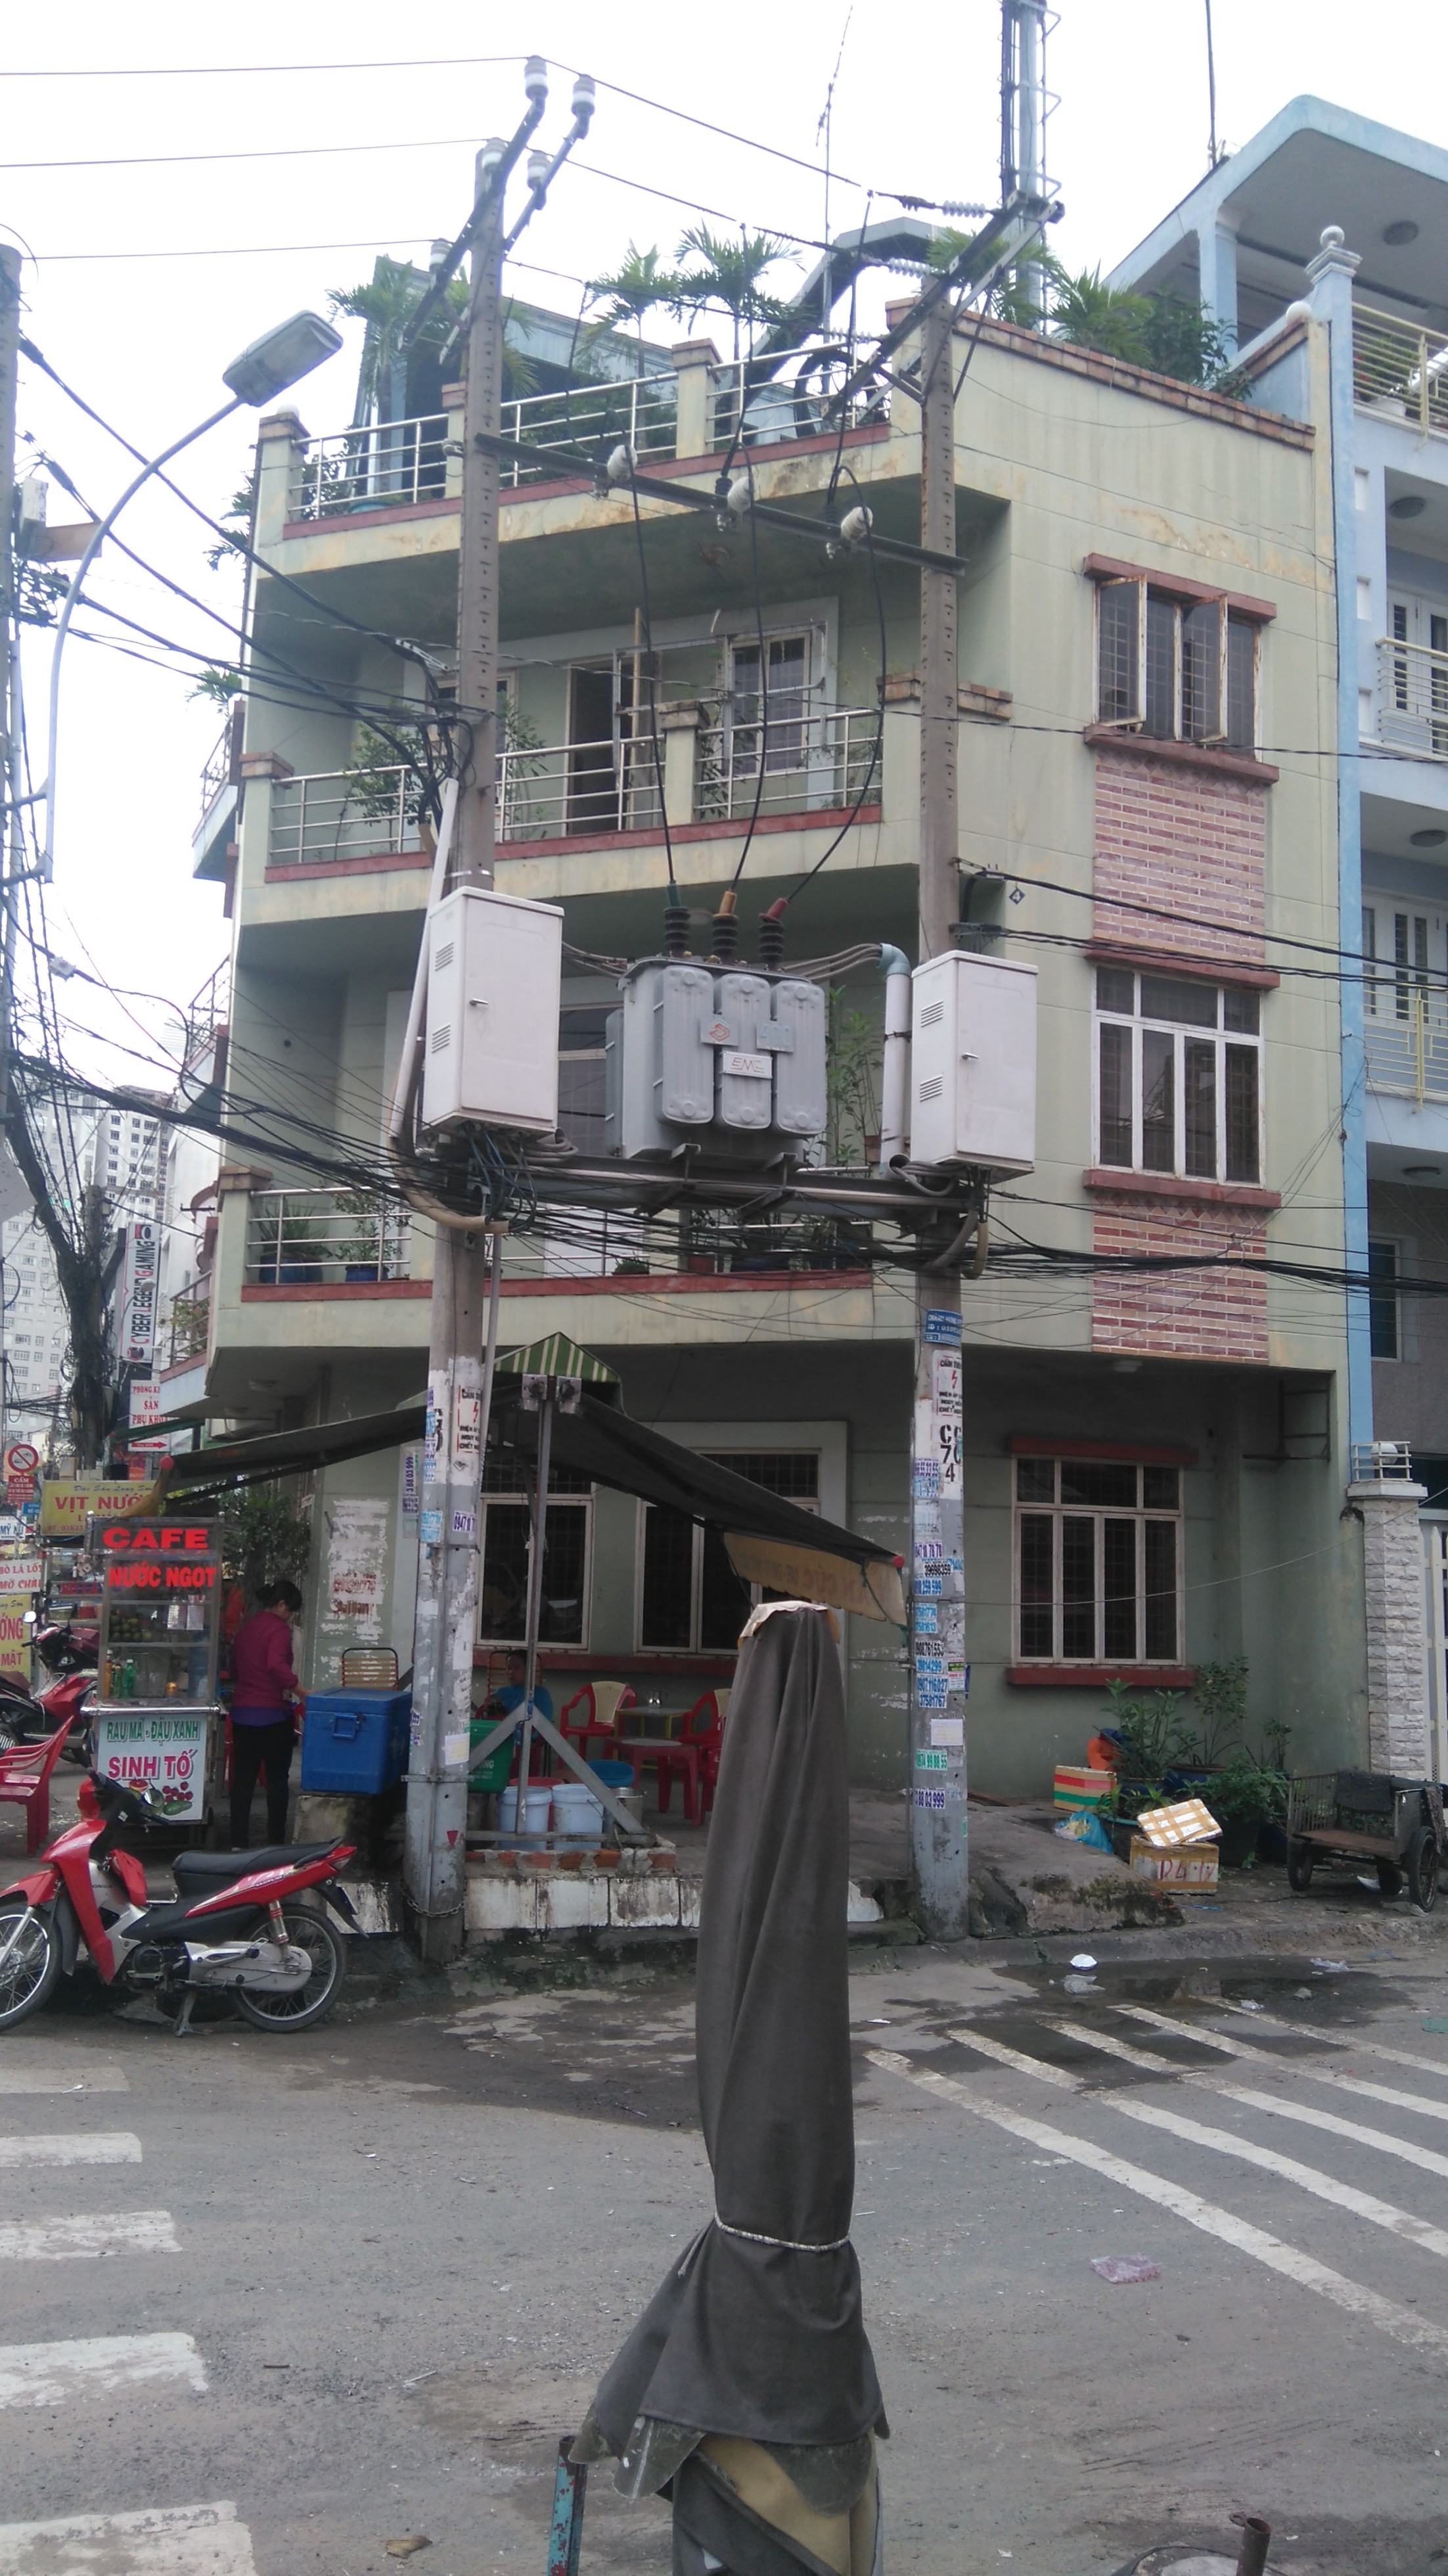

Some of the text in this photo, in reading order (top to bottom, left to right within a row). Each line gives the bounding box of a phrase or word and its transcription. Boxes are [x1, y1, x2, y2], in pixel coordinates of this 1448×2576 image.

[135, 1240, 155, 1277] GAMING
[131, 1314, 151, 1345] CYBER
[133, 1385, 152, 1393] PHÒNG
[945, 1463, 955, 1482] 4
[55, 1496, 89, 1513] VỊT
[102, 1527, 208, 1549] CAFE
[12, 1563, 24, 1574] LÁ
[108, 1561, 161, 1588] NƯỚC
[1, 1649, 22, 1668] MẬT
[107, 1722, 128, 1741] RAU
[150, 1718, 172, 1745] ĐẬU
[173, 1720, 200, 1740] XANH
[108, 1749, 198, 1780] SINH TỐ
